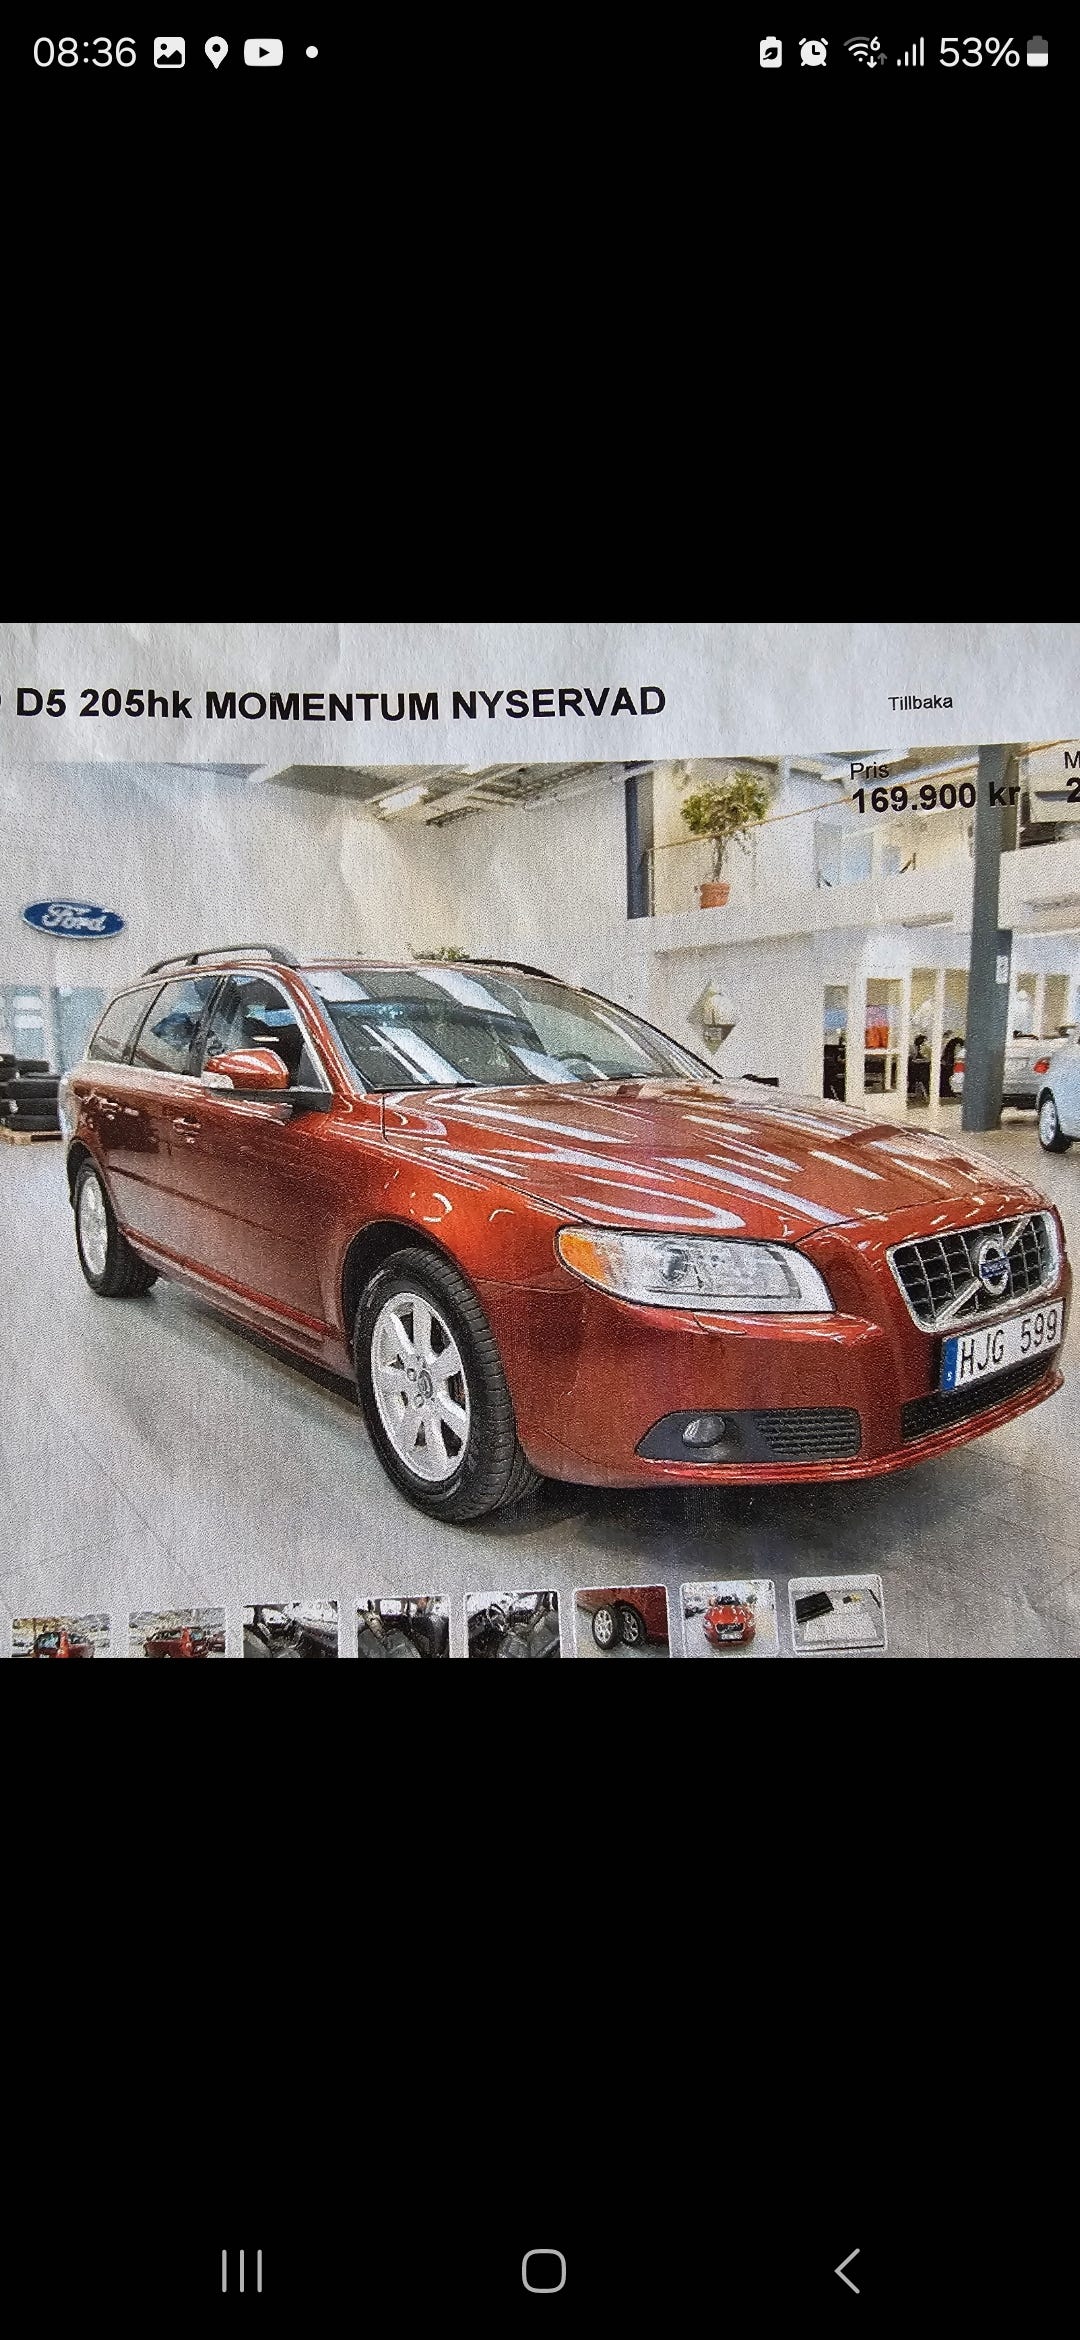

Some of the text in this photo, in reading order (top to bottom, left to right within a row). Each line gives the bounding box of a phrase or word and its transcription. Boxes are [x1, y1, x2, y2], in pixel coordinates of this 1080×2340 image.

[17, 687, 665, 721] D5 205hk MOMENTUM NYSERVAD
[888, 695, 953, 711] Tillbaka
[851, 762, 889, 779] Pris
[852, 781, 1020, 813] 169.900 kr
[41, 903, 107, 931] Ford
[960, 1308, 1058, 1379] HJG 599
